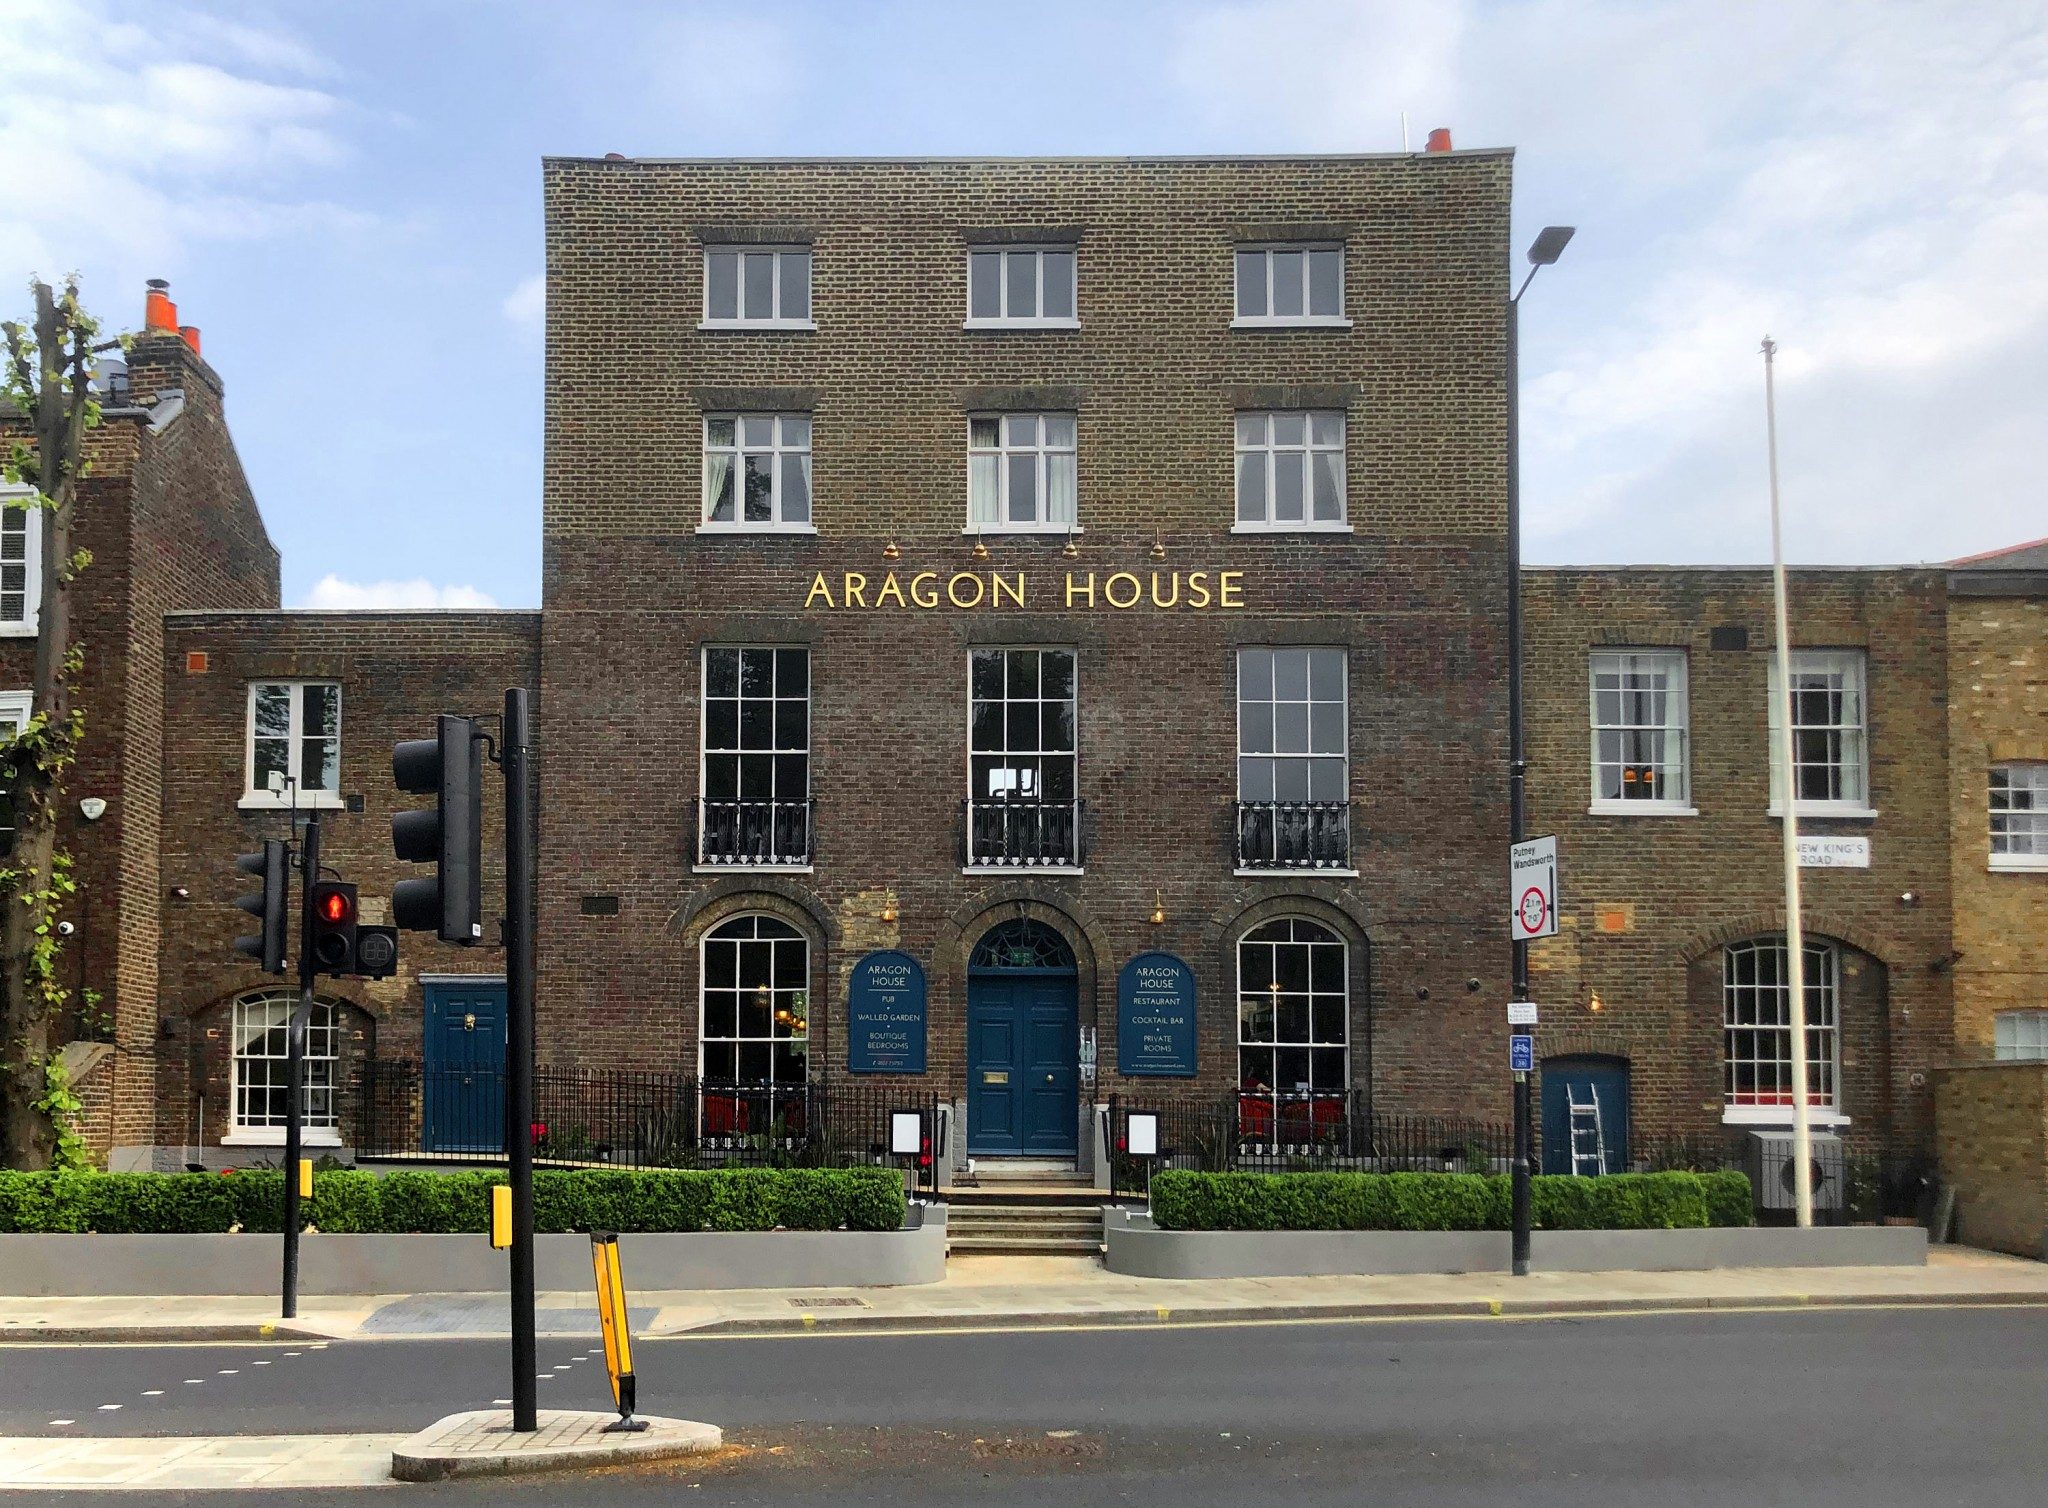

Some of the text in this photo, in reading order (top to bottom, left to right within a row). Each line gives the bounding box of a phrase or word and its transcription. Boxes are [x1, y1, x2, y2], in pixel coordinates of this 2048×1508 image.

[804, 571, 1245, 608] ARAGON HOUSE
[1513, 846, 1536, 858] Putney
[1513, 853, 1554, 869] Wandsworth
[1801, 855, 1832, 864] ROAD
[867, 965, 911, 975] ARAGON
[1135, 967, 1180, 977] ARAGON
[872, 977, 905, 986] HOUSE
[1140, 979, 1174, 989] HOUSE
[881, 995, 895, 1003] PUB
[1133, 997, 1181, 1005] RESTAURANT
[1131, 1016, 1168, 1024] COCKTAIL
[869, 1032, 907, 1040] BOUTIQUE
[867, 1041, 909, 1049] BEDROOMS
